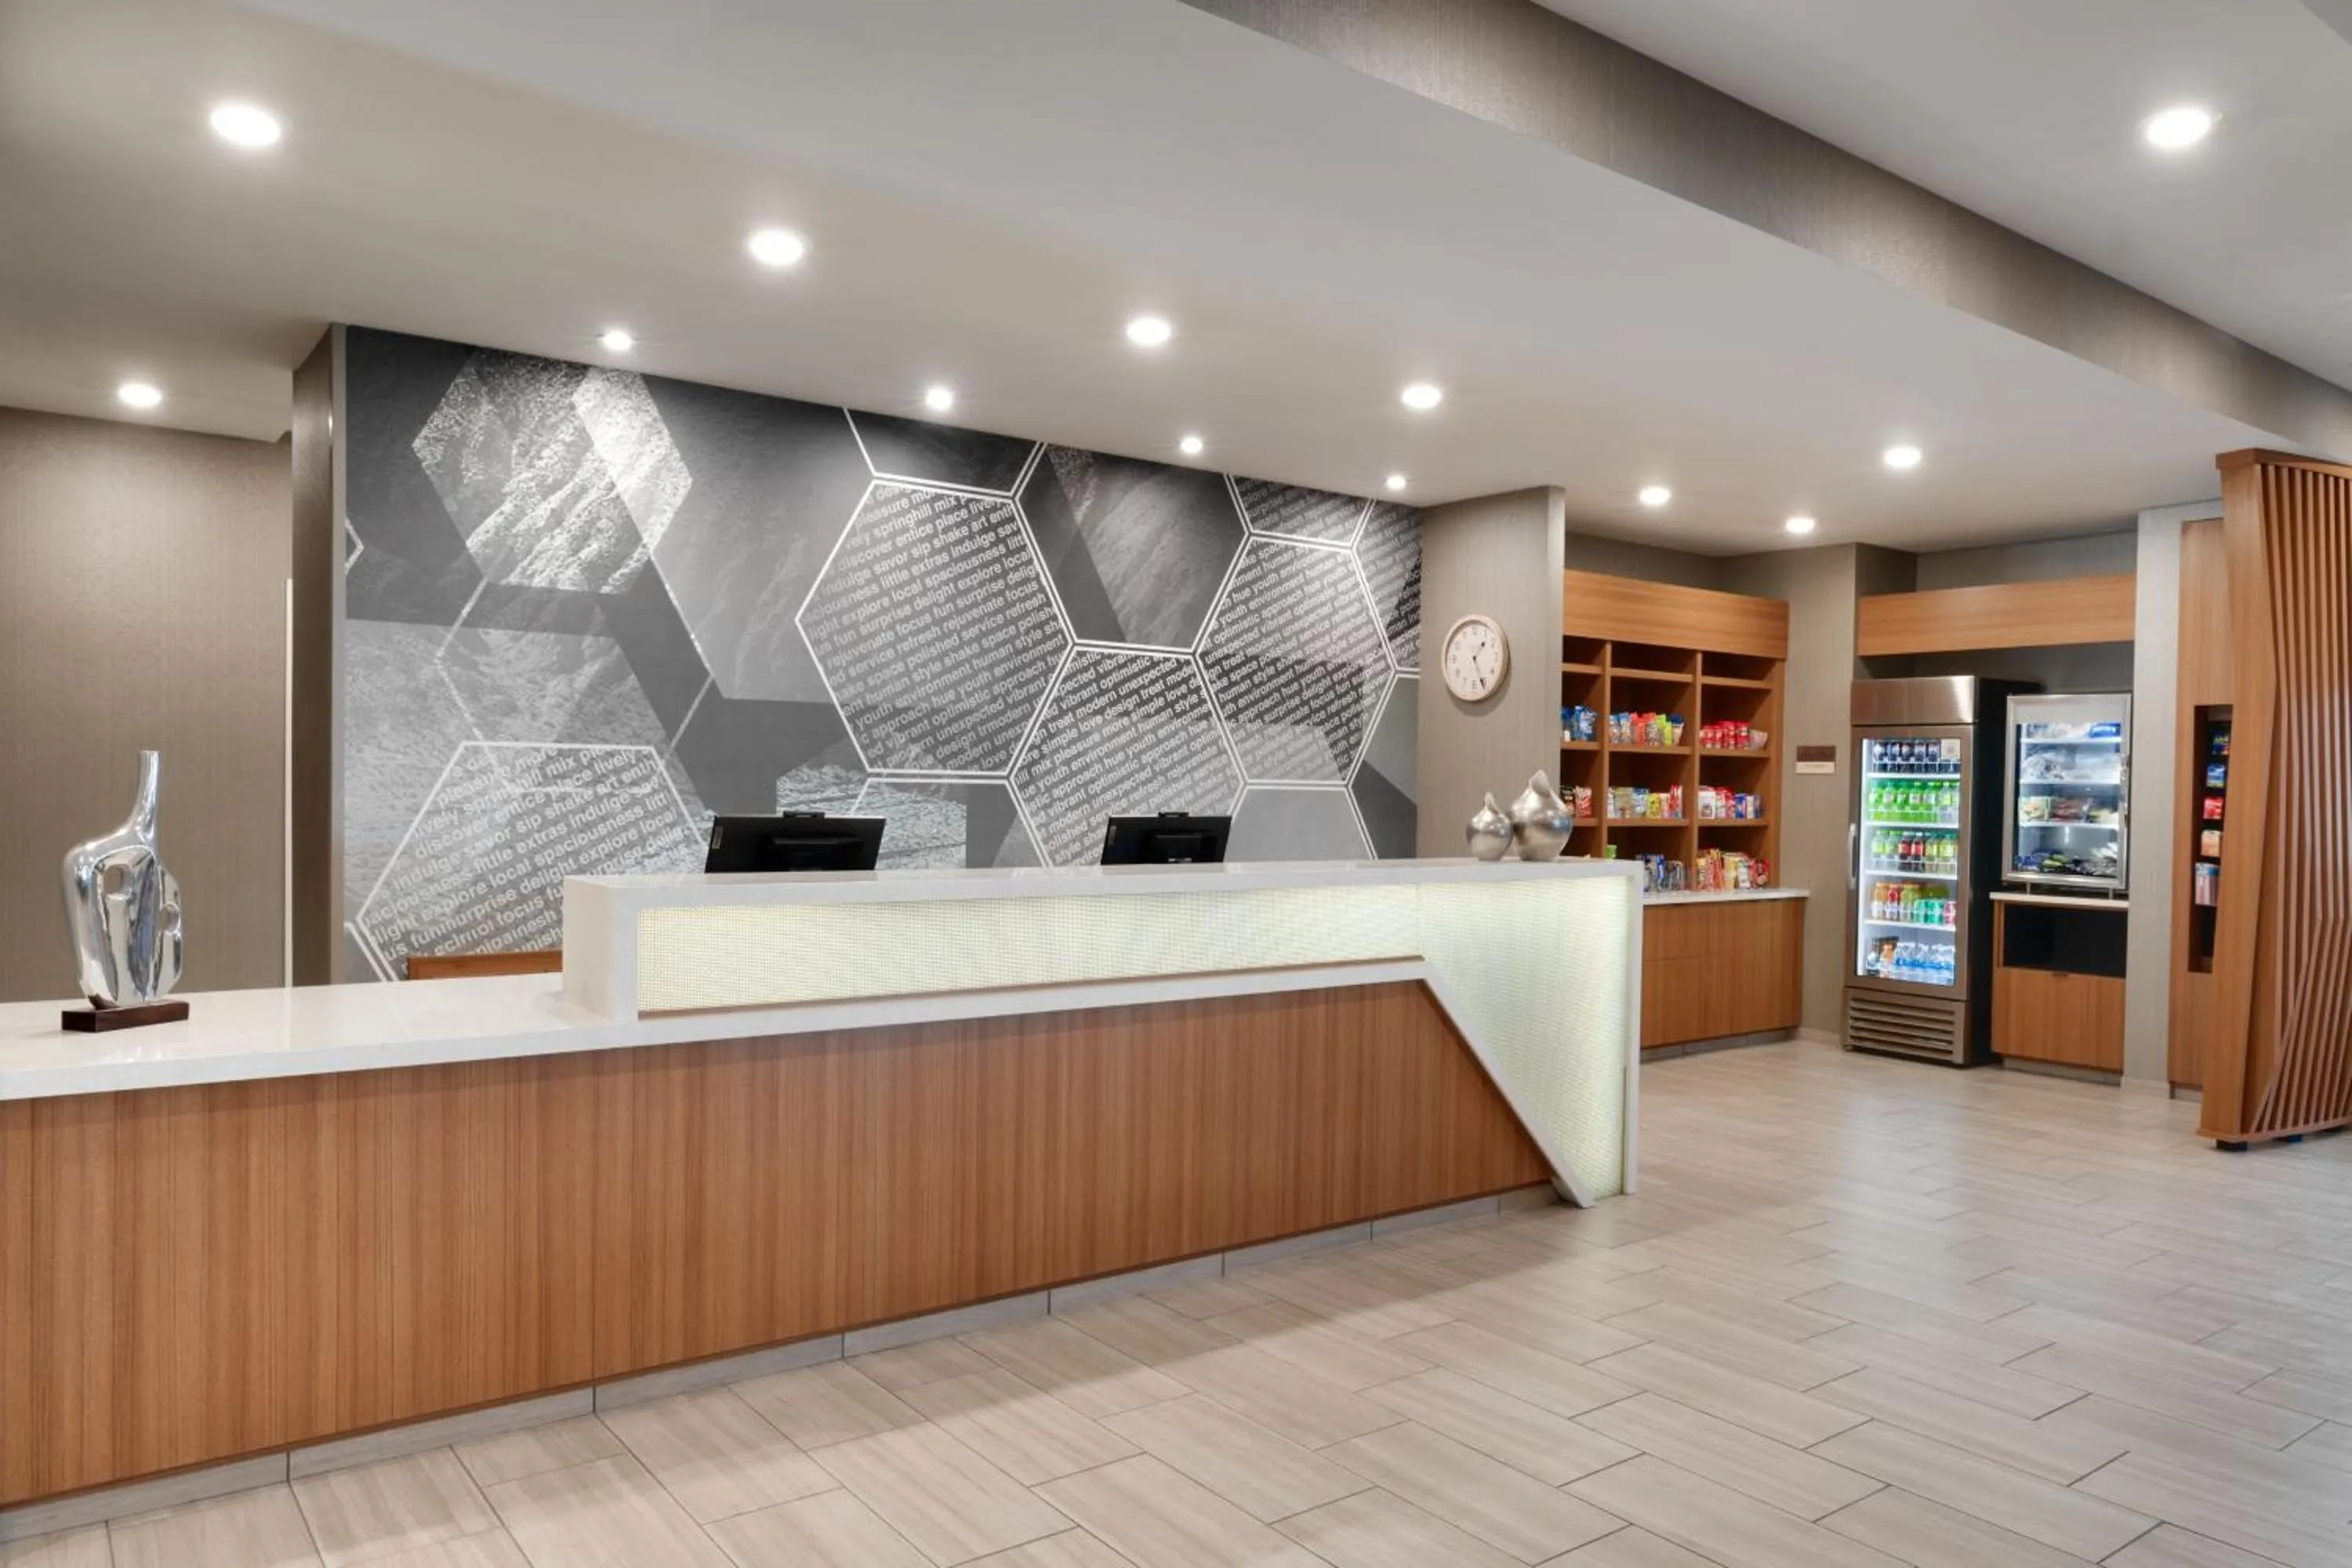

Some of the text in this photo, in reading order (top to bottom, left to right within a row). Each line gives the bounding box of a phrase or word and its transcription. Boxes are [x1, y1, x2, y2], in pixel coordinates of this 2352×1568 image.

[891, 579, 922, 601] local
[547, 756, 576, 776] mix
[516, 813, 543, 833] sip
[546, 789, 594, 818] shake
[489, 857, 531, 888] local
[535, 806, 644, 866] spaciousness
[518, 856, 575, 893] delight
[579, 828, 638, 864] explore
